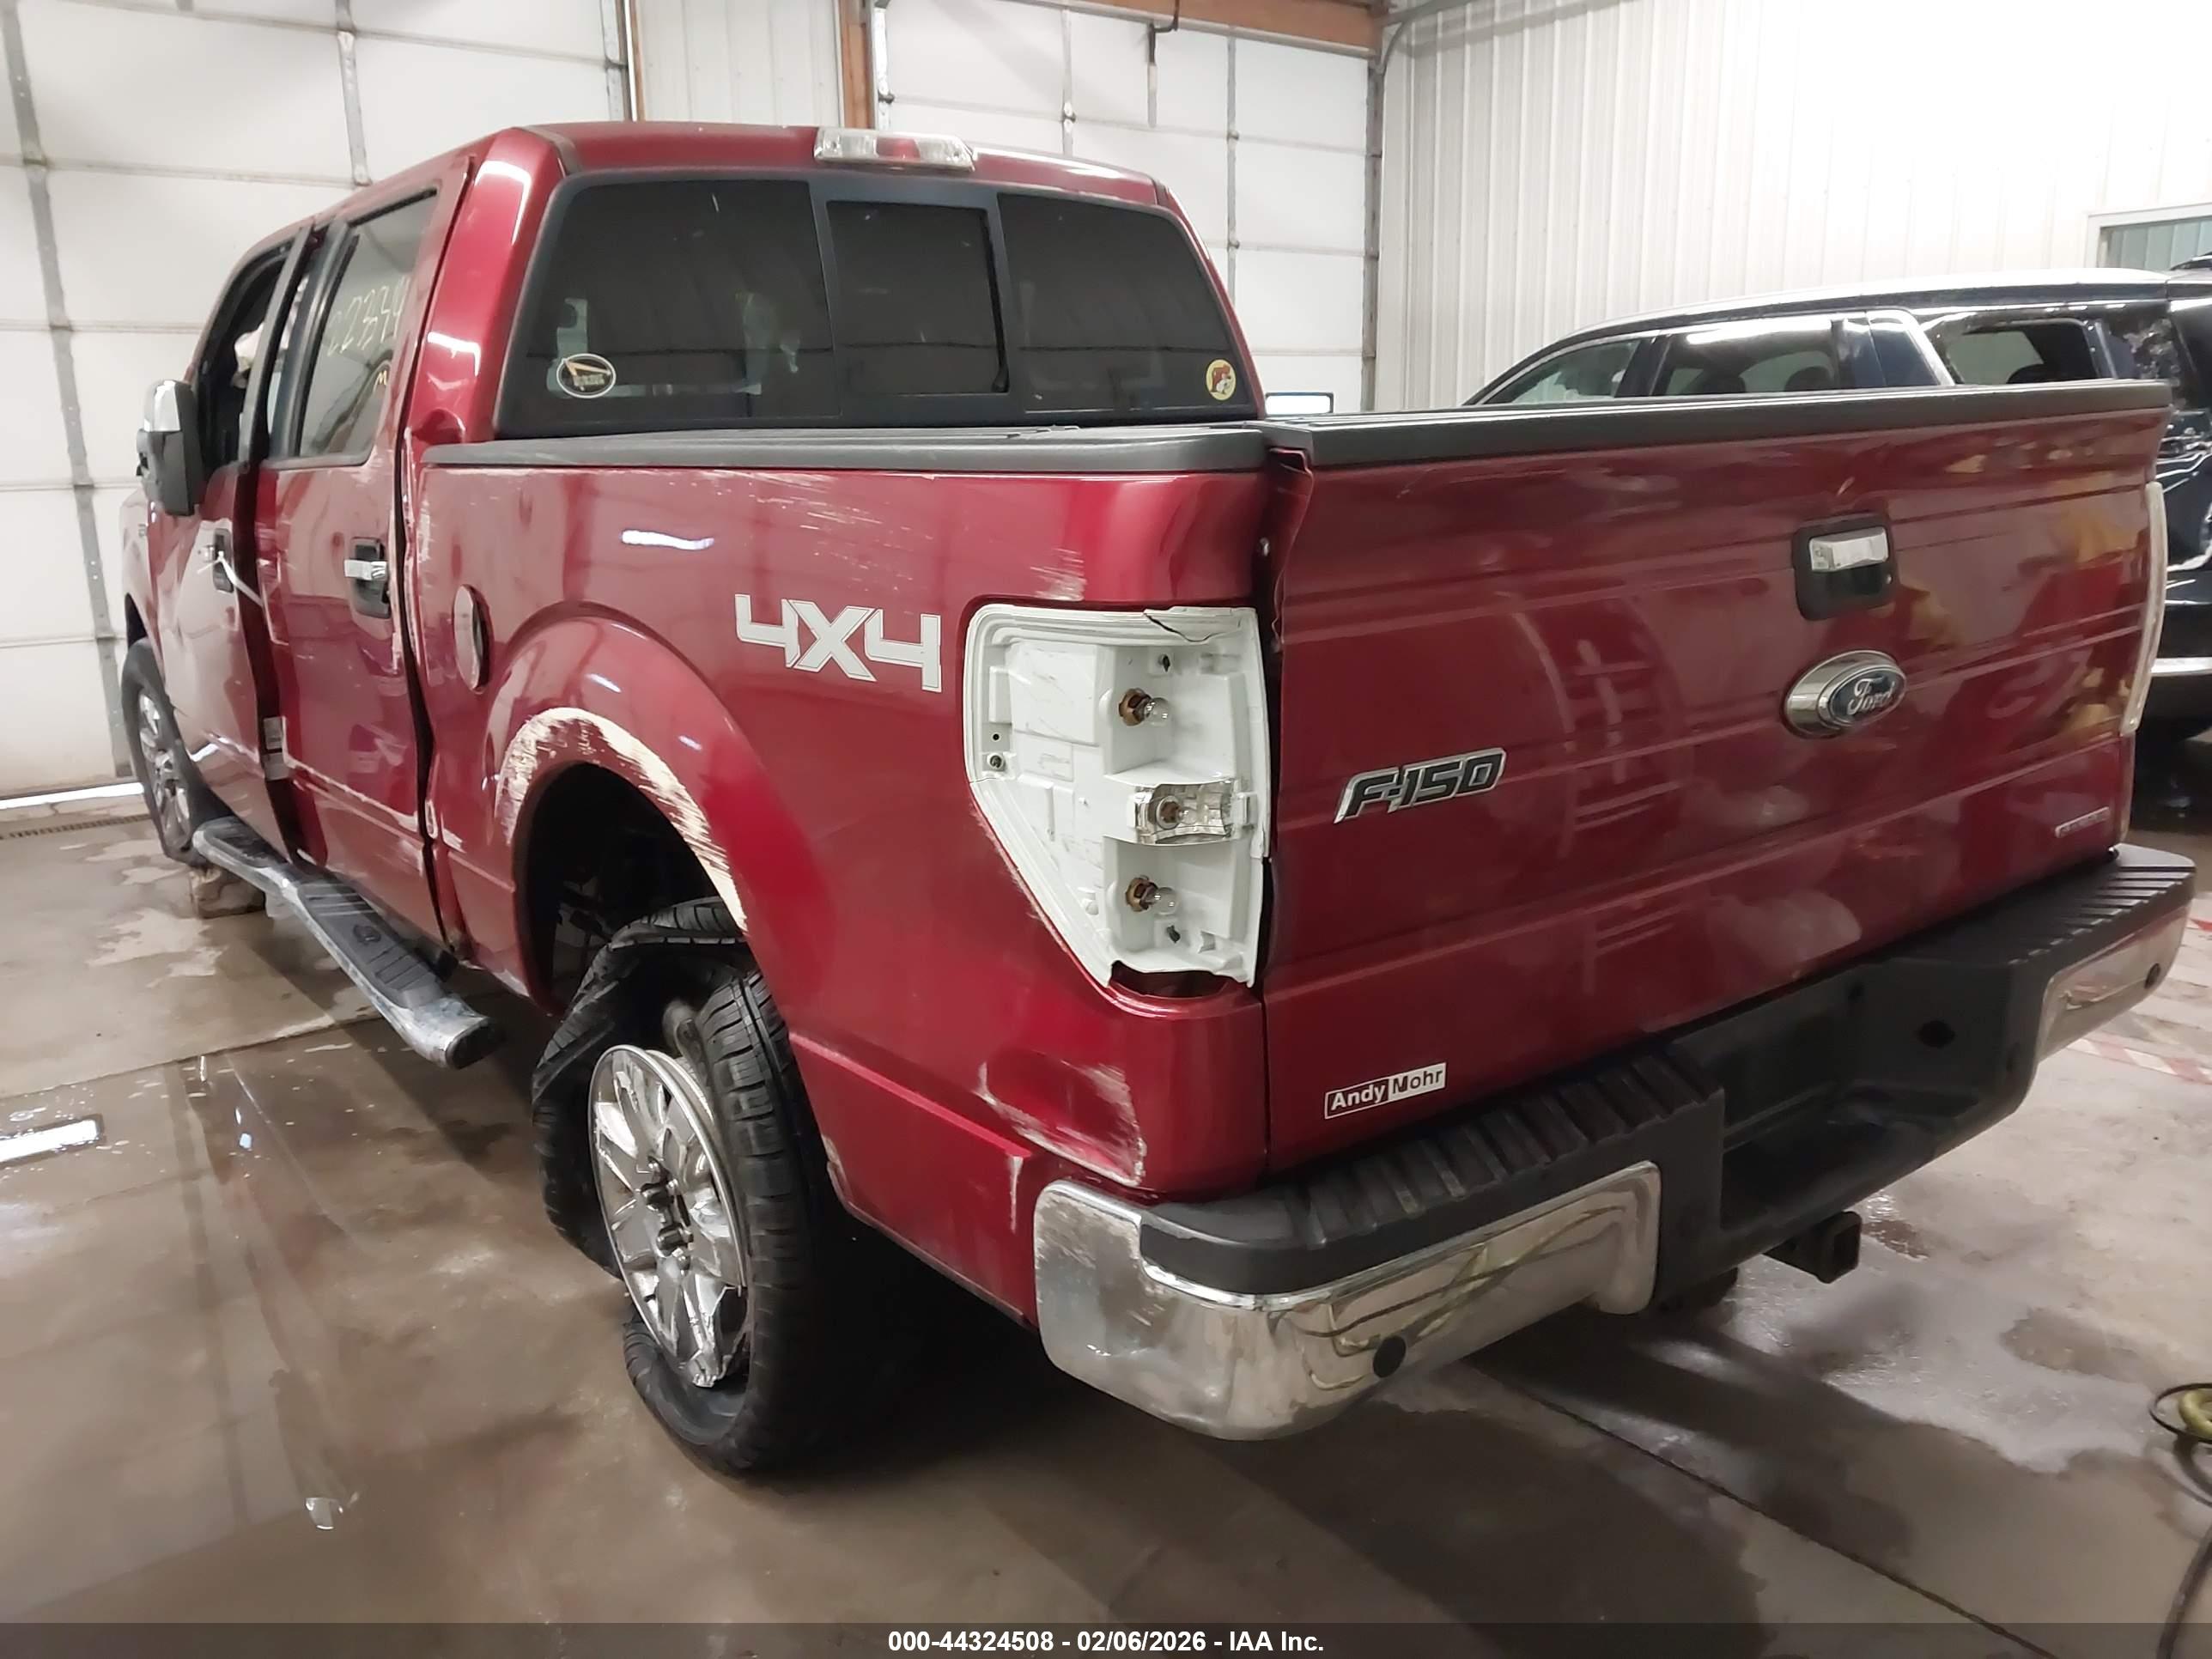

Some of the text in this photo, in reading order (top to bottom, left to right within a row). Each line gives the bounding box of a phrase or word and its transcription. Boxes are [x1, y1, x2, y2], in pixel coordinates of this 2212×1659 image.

[1846, 675, 1896, 715] Ford
[1334, 747, 1506, 824] F-150
[1331, 1070, 1443, 1111] Andy Mohr
